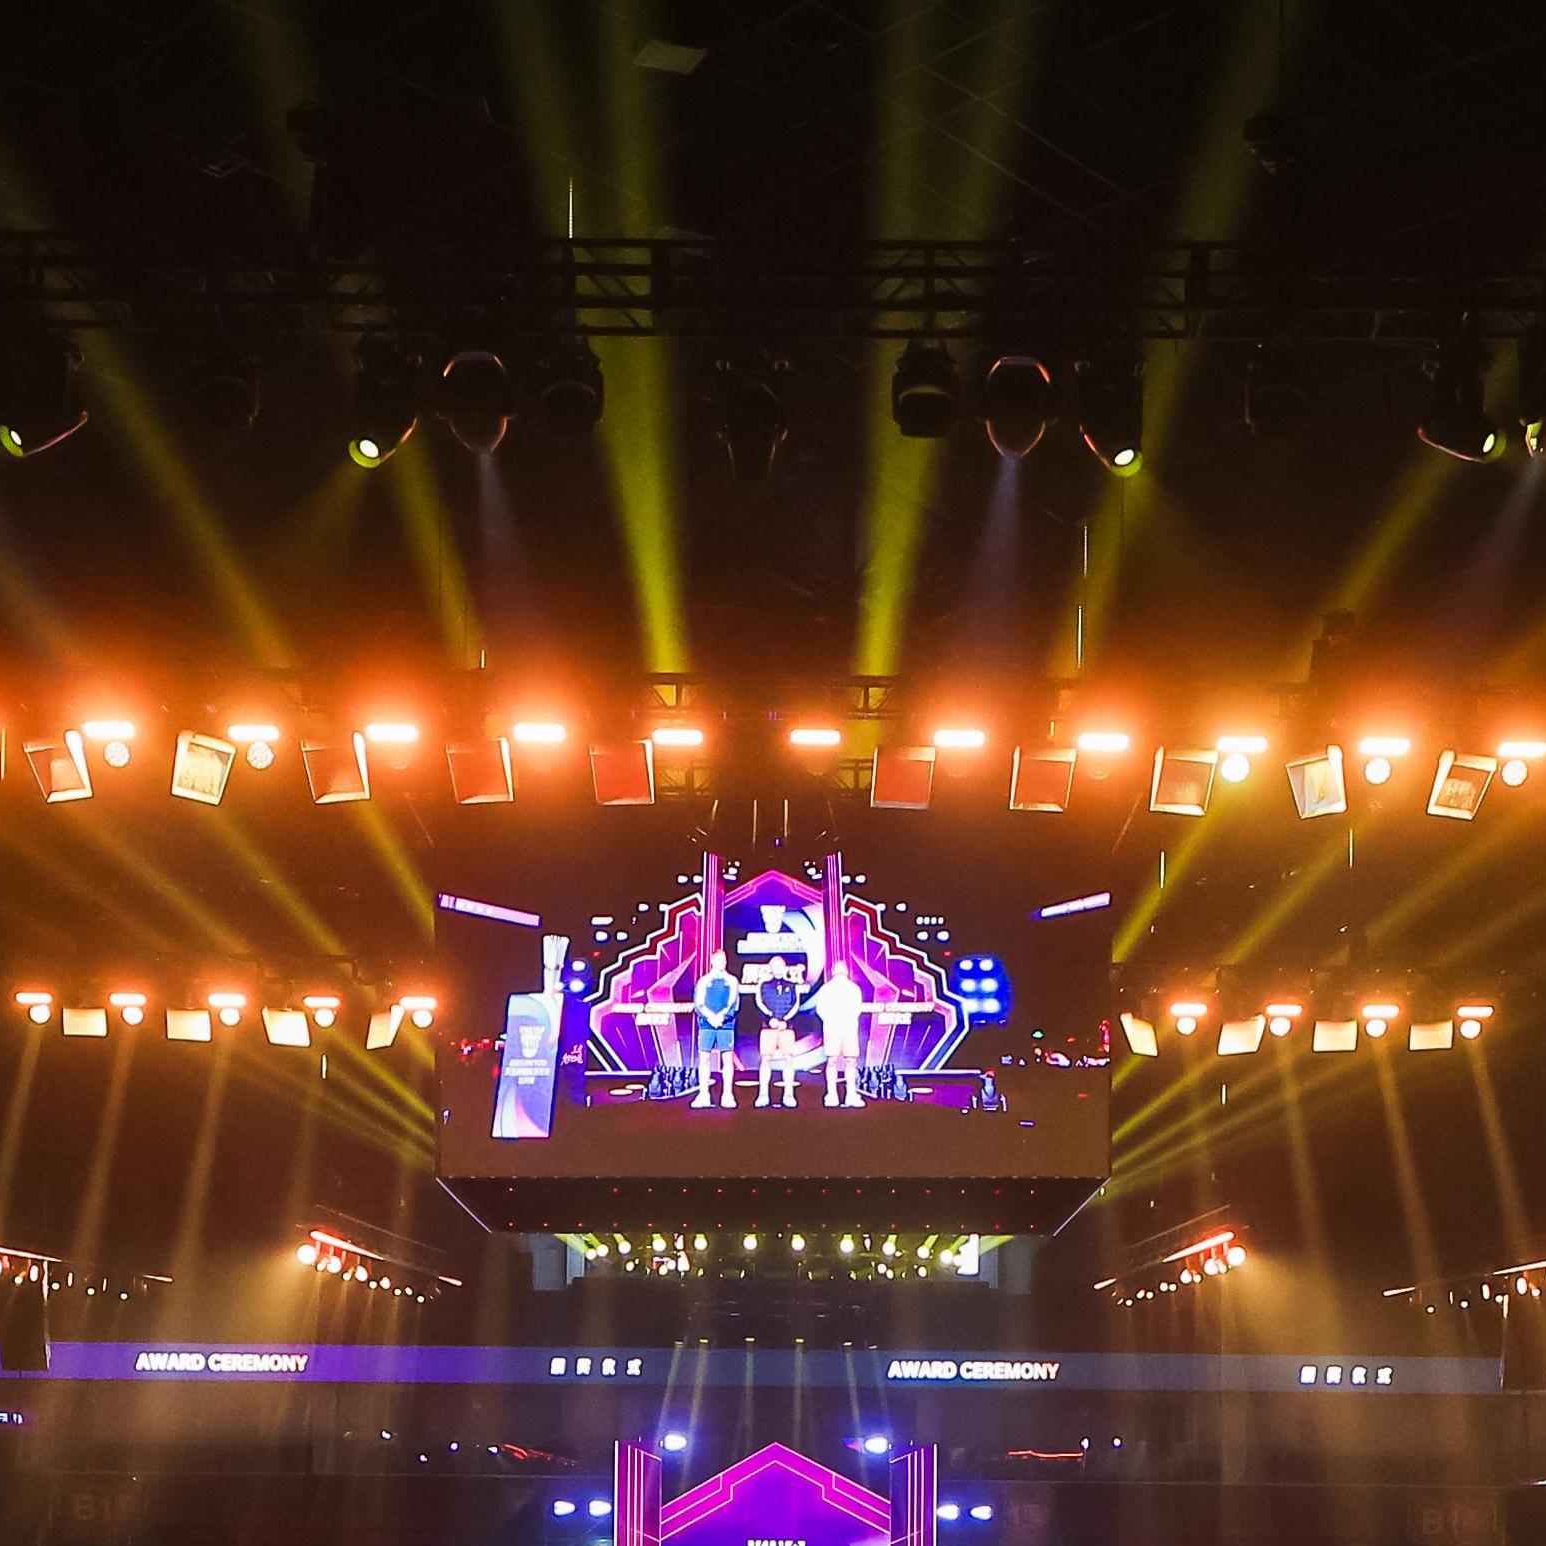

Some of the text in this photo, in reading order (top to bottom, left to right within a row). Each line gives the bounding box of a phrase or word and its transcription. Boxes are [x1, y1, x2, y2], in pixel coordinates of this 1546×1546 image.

[135, 1352, 308, 1372] AWARD CEREMONY
[887, 1360, 1060, 1380] AWARD CEREMONY
